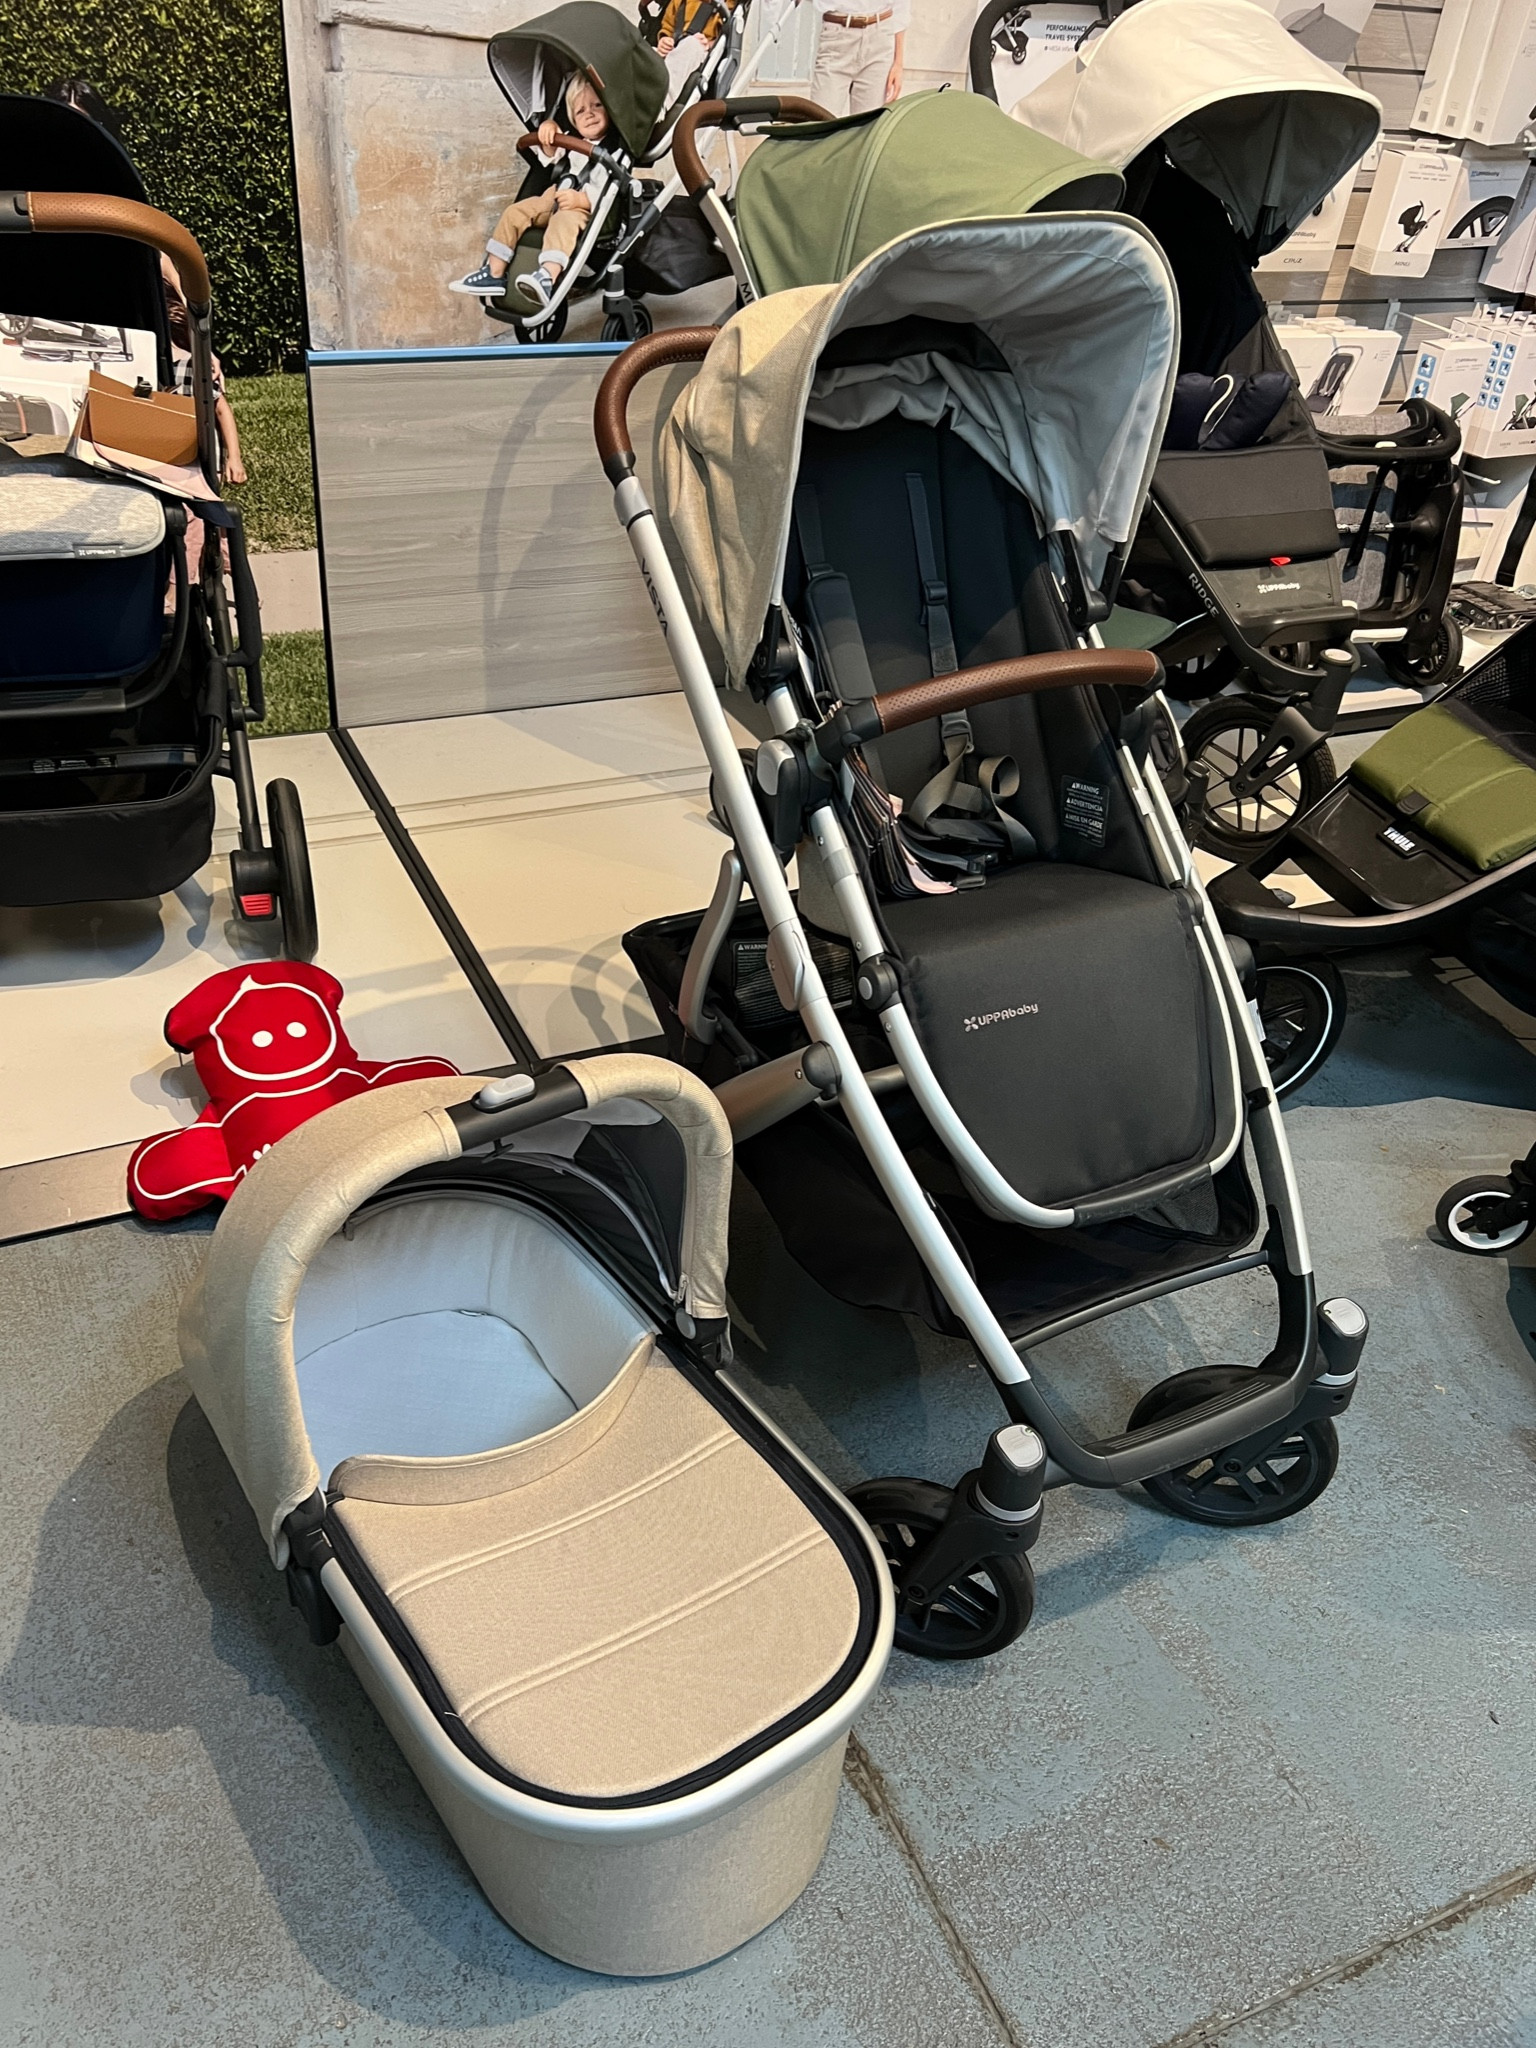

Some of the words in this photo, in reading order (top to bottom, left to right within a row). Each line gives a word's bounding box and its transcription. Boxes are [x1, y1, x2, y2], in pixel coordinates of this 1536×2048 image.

[1067, 34, 1081, 42] SYST
[740, 282, 756, 304] MI
[641, 558, 669, 638] VISTA
[1188, 572, 1220, 618] RIDGE
[1383, 826, 1416, 851] THULE
[977, 1003, 1039, 1026] UPPAbaby
